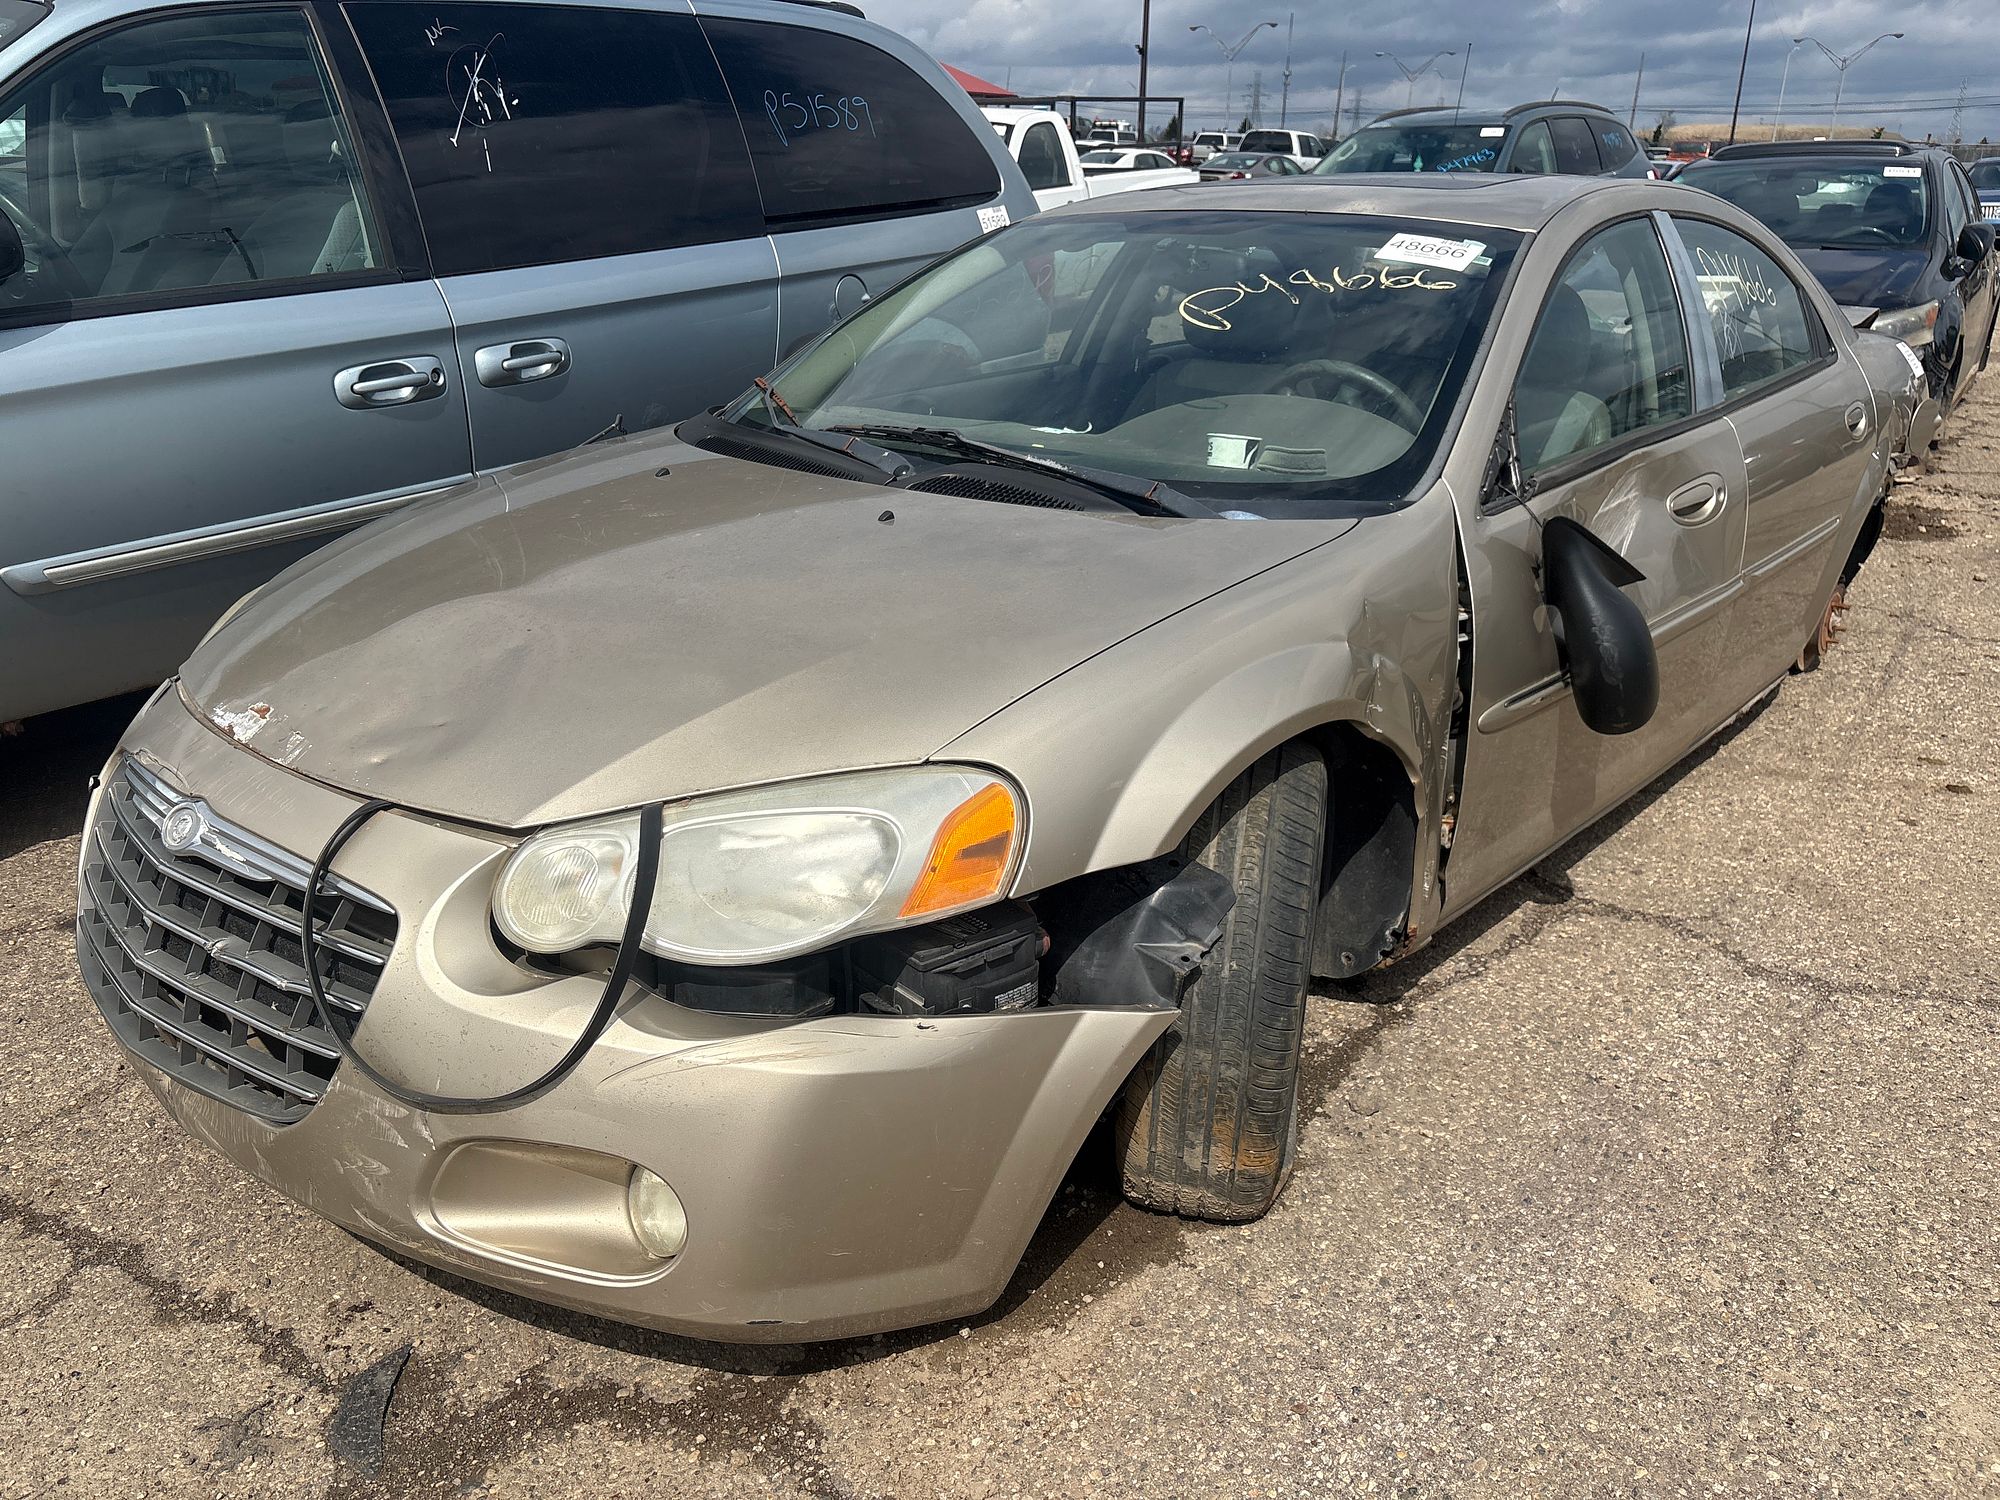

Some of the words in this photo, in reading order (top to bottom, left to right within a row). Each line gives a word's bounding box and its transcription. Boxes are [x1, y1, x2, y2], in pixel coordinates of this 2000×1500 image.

[763, 88, 878, 147] P51589
[981, 214, 1007, 229] 51589
[1389, 239, 1468, 259] 48666
[1178, 266, 1457, 331] P48666
